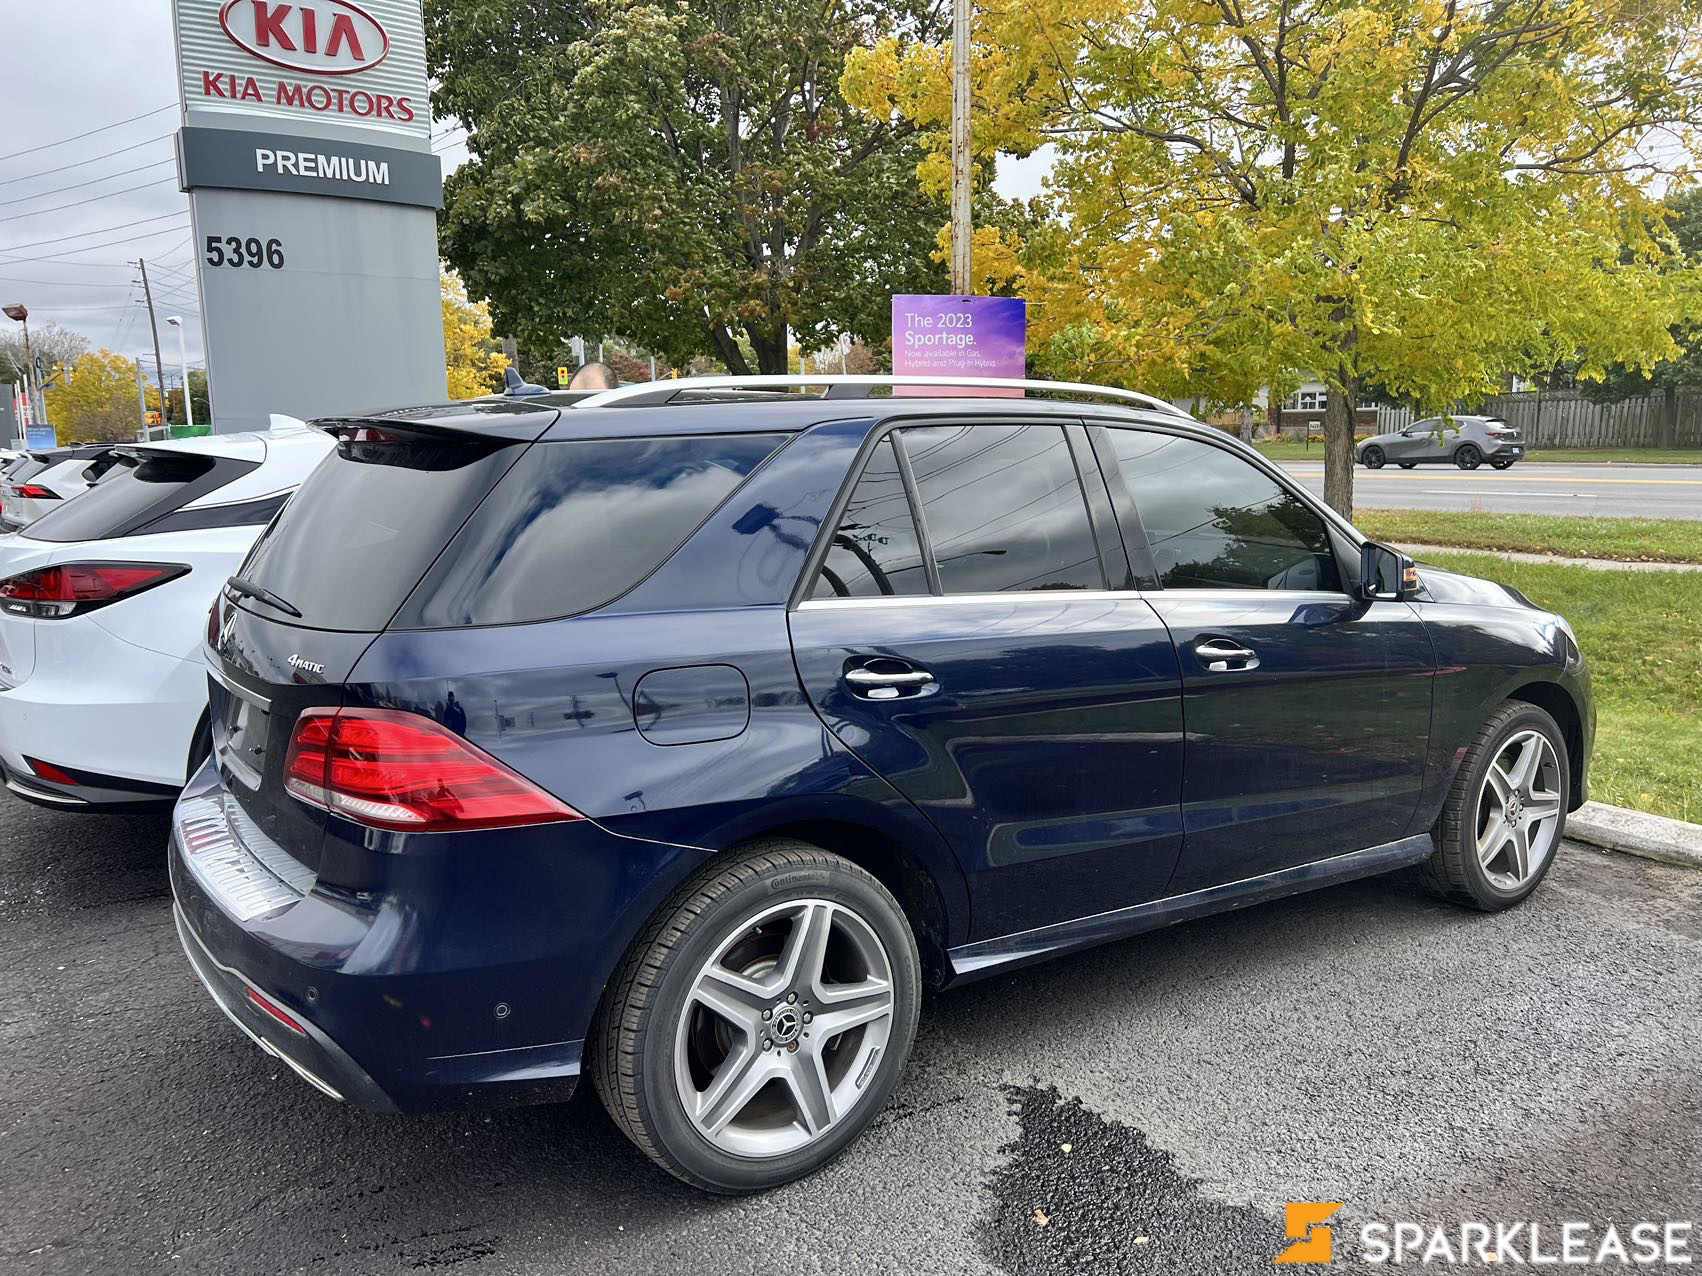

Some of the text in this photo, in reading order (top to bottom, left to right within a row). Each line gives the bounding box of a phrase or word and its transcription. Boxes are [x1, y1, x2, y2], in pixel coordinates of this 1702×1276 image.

[253, 1, 365, 61] KIA
[202, 71, 415, 122] KIA MOTORS
[255, 148, 390, 185] PREMIUM
[206, 236, 285, 269] 5396
[904, 313, 973, 328] The 2023
[904, 330, 977, 349] Sportage.
[287, 654, 325, 673] 4MATIC
[770, 871, 826, 890] Contin
